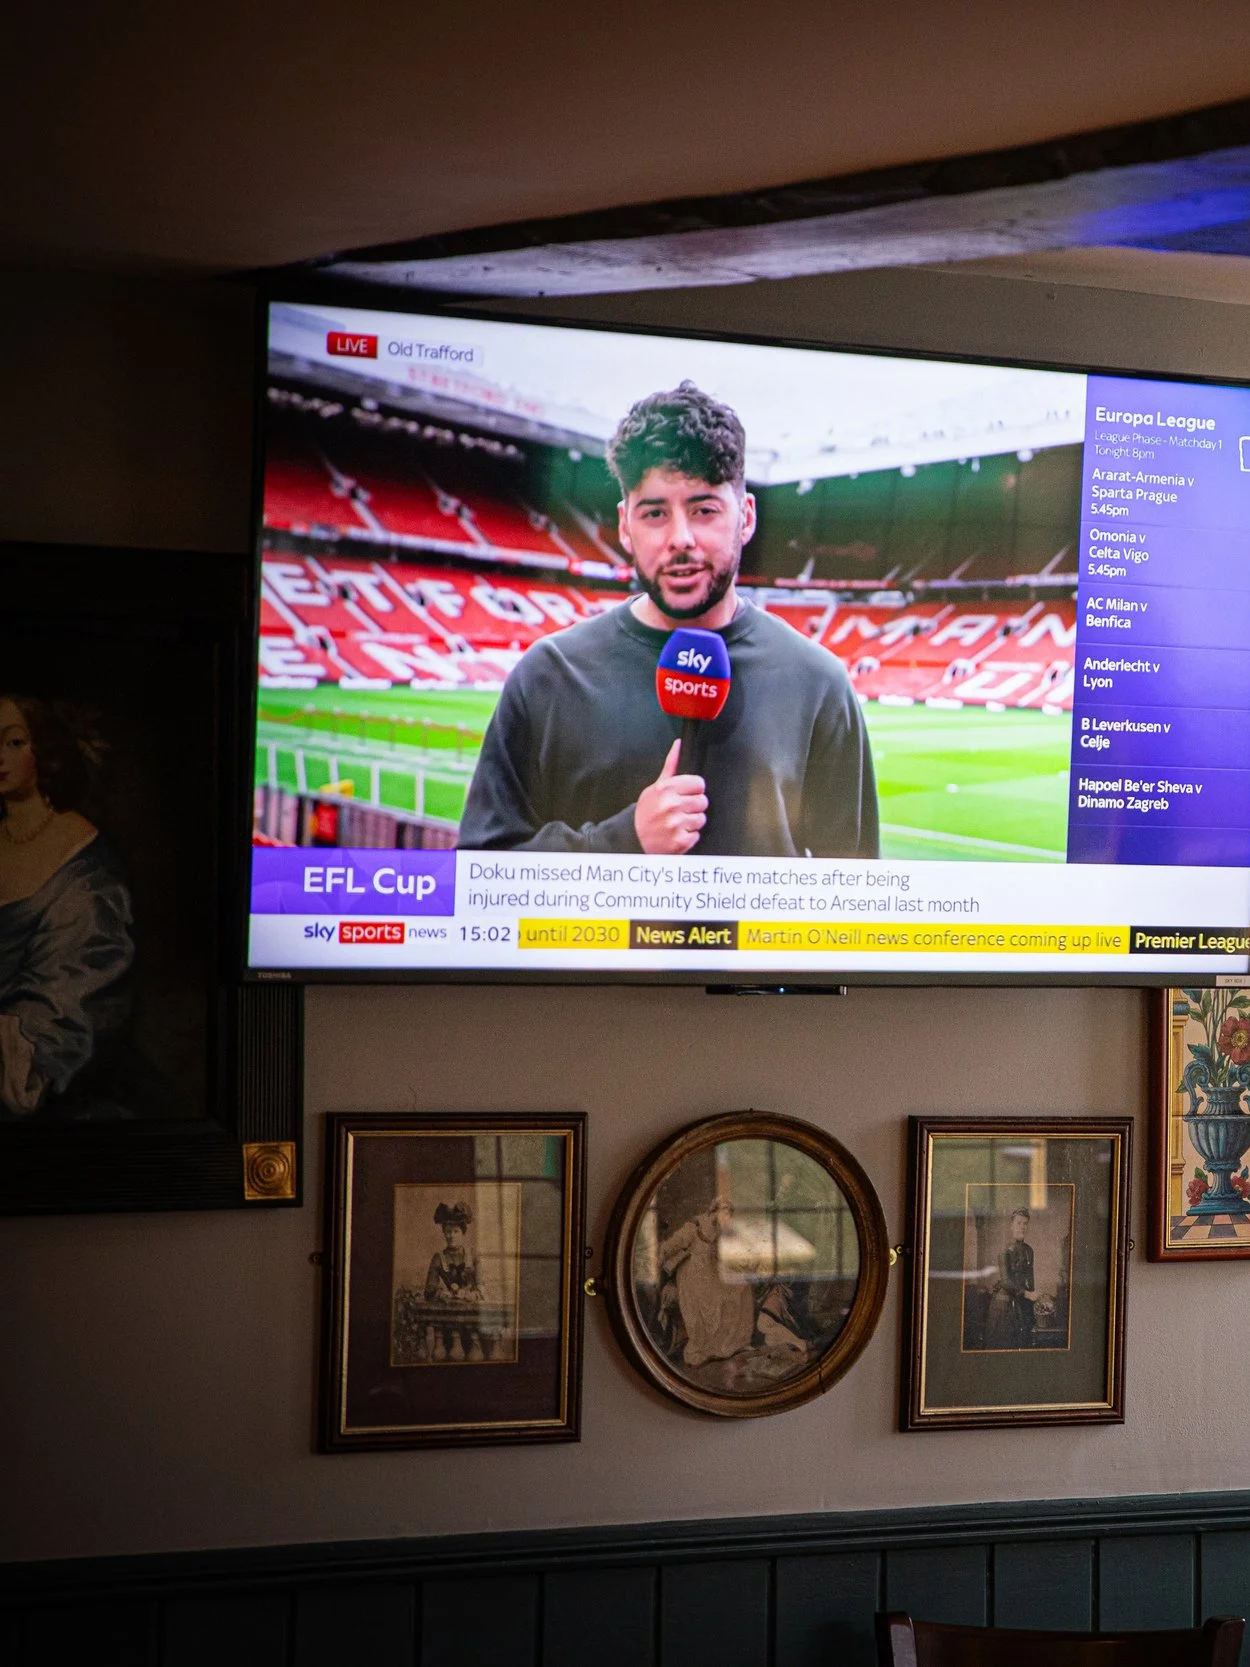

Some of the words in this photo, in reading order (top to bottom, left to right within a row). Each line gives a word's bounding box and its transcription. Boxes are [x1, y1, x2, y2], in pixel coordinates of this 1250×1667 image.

[336, 338, 369, 353] LIVE
[388, 341, 413, 357] Old
[416, 343, 474, 362] Trafford
[1095, 406, 1154, 426] Europa
[1157, 412, 1216, 432] League
[1094, 431, 1130, 445] League
[1133, 433, 1162, 446] Phase
[1169, 436, 1217, 450] Matchday
[1218, 440, 1223, 449] 1
[1094, 445, 1130, 459] Tonight
[1132, 449, 1155, 460] 8pm
[1092, 467, 1185, 486] Ararat-Armenia
[1187, 477, 1195, 487] v
[1091, 485, 1133, 500] Sparta
[1136, 488, 1178, 505] Prague
[1090, 503, 1129, 517] 5.45pm
[1089, 528, 1137, 543] Omonia
[1139, 534, 1146, 544] v
[1088, 545, 1121, 561] Celta
[1123, 548, 1149, 564] Vigo
[1087, 563, 1127, 578] 5.45pm
[1086, 597, 1104, 610] AC
[1106, 598, 1138, 612] Milan
[1140, 602, 1148, 612] v
[1086, 614, 1132, 629] Benfica
[677, 648, 712, 674] sky
[1083, 657, 1151, 673] Anderlecht
[1152, 663, 1160, 673] v
[664, 677, 718, 698] sports
[1083, 675, 1113, 690] Lyon
[1081, 717, 1090, 730] B
[1092, 718, 1161, 733] Leverkusen
[1164, 724, 1171, 734] v
[1080, 735, 1110, 751] Celje
[1078, 778, 1122, 794] Hapoel
[1124, 779, 1155, 793] Be'er
[1157, 780, 1193, 794] Sheva
[1195, 784, 1203, 794] v
[1078, 795, 1125, 809] Dinamo
[1127, 796, 1169, 813] Zagreb
[303, 866, 366, 894] EFL
[373, 868, 437, 900] Cup
[470, 863, 515, 881] Doku
[519, 865, 582, 882] missed
[587, 866, 624, 882] Man
[628, 866, 674, 889] City's
[677, 866, 708, 884] last
[713, 867, 743, 885] five
[747, 868, 818, 886] matches
[822, 869, 862, 887] after
[866, 870, 911, 891] being
[468, 889, 529, 909] injured
[533, 890, 590, 911] during
[594, 890, 692, 912] Community
[695, 892, 747, 911] Shield
[750, 893, 805, 911] defeat
[809, 896, 826, 911] to
[830, 894, 891, 912] Arsenal
[894, 896, 924, 913] last
[927, 897, 980, 913] month
[304, 922, 335, 942] sky
[342, 924, 401, 944] sports
[408, 927, 447, 939] news
[460, 926, 511, 942] 15:02
[526, 925, 567, 942] until
[572, 926, 620, 942] 2030
[636, 926, 685, 944] News
[687, 927, 731, 945] Alert
[747, 928, 803, 945] Martin
[808, 929, 861, 946] O'Neill
[866, 934, 908, 946] news
[913, 929, 1006, 947] conference
[1009, 932, 1067, 951] coming
[1072, 935, 1090, 951] up
[1096, 931, 1122, 948] live
[1135, 932, 1196, 949] Premier
[1199, 933, 1250, 953] League
